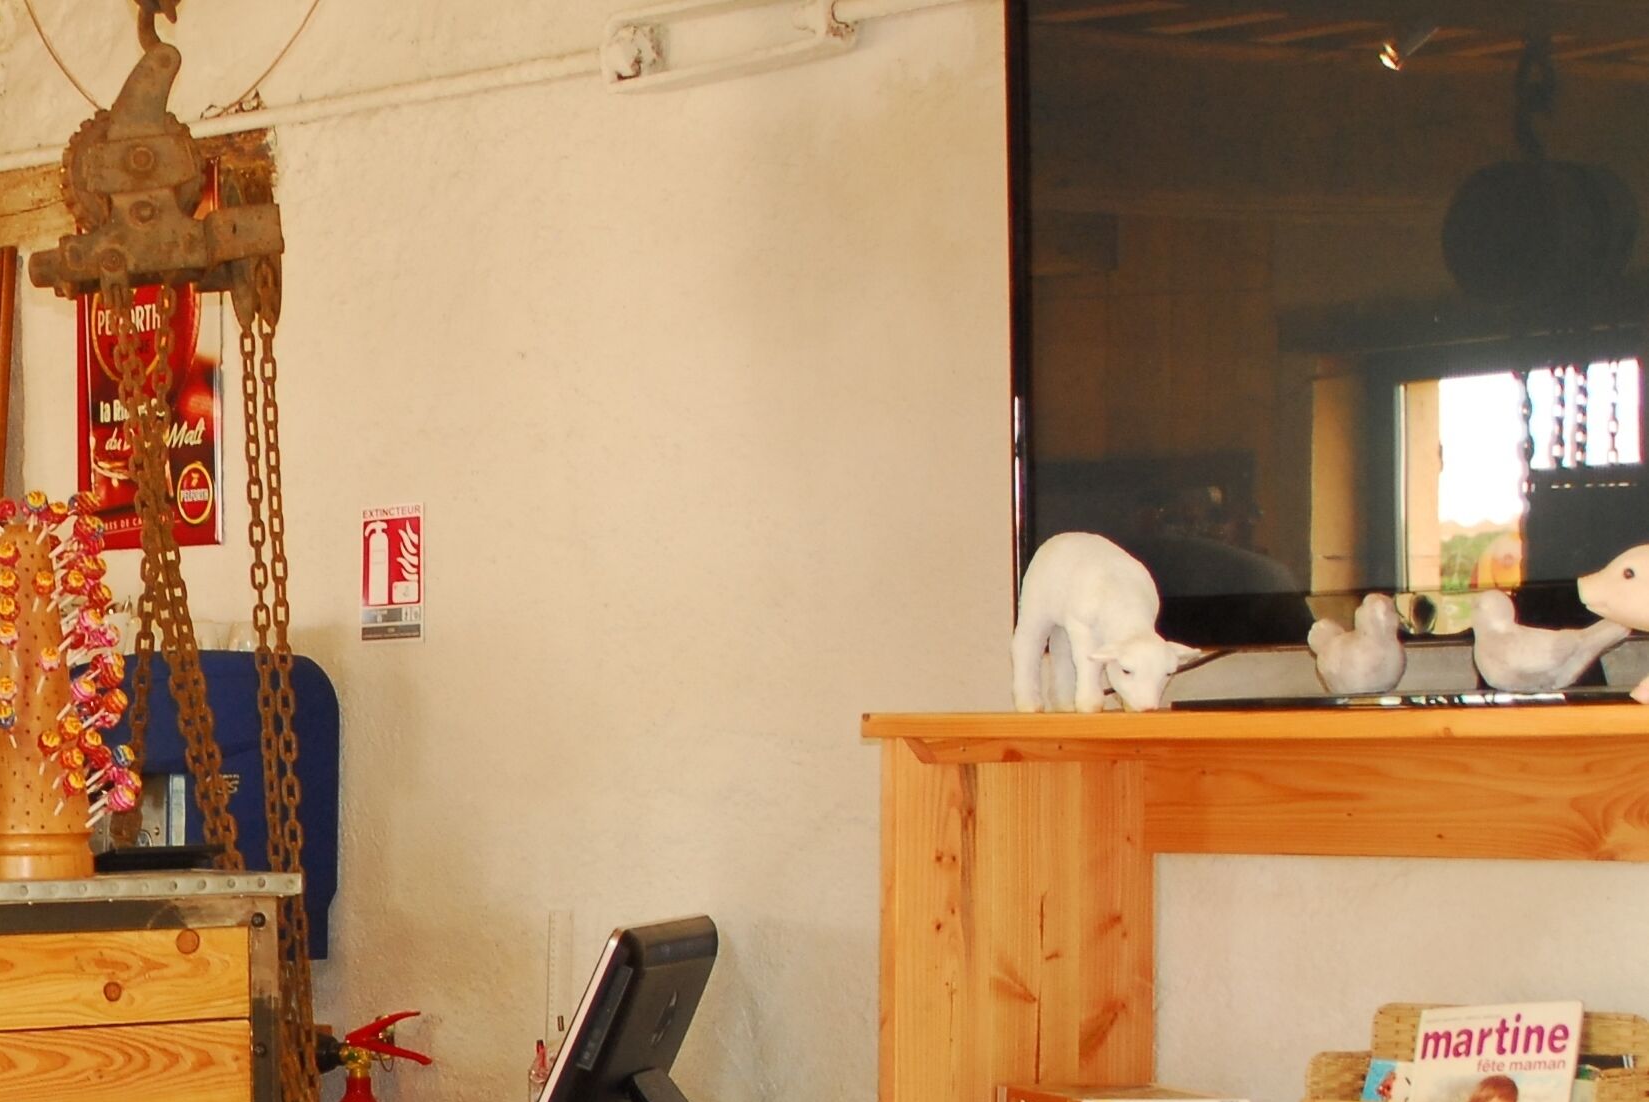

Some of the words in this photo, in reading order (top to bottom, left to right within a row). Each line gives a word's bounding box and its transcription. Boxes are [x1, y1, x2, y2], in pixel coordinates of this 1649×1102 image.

[163, 417, 206, 449] Malt
[362, 504, 420, 519] EXTINCTEUR
[1420, 1002, 1571, 1061] martine
[1476, 1058, 1506, 1073] fête
[1509, 1058, 1566, 1072] maman
